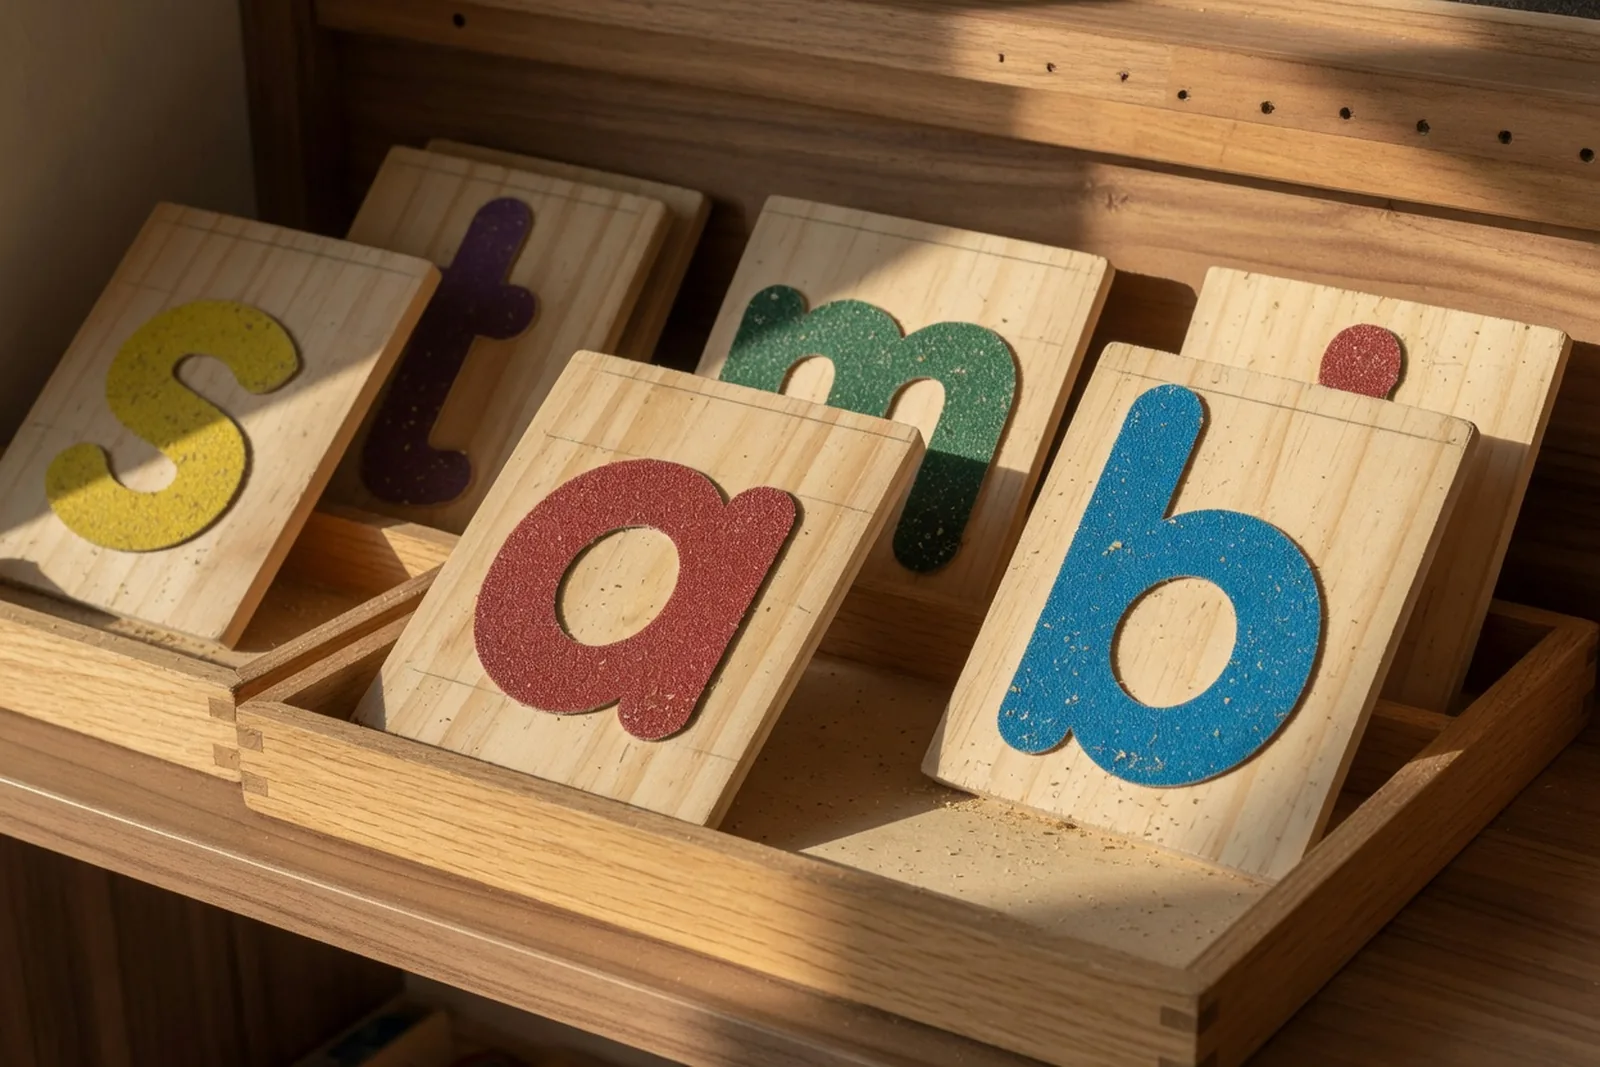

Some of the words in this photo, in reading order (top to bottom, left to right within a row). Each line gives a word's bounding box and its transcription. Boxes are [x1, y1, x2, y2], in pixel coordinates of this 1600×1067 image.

[45, 298, 300, 551] s
[362, 196, 537, 504] t
[721, 285, 1020, 573] m
[474, 459, 800, 742] a
[998, 384, 1323, 789] b
